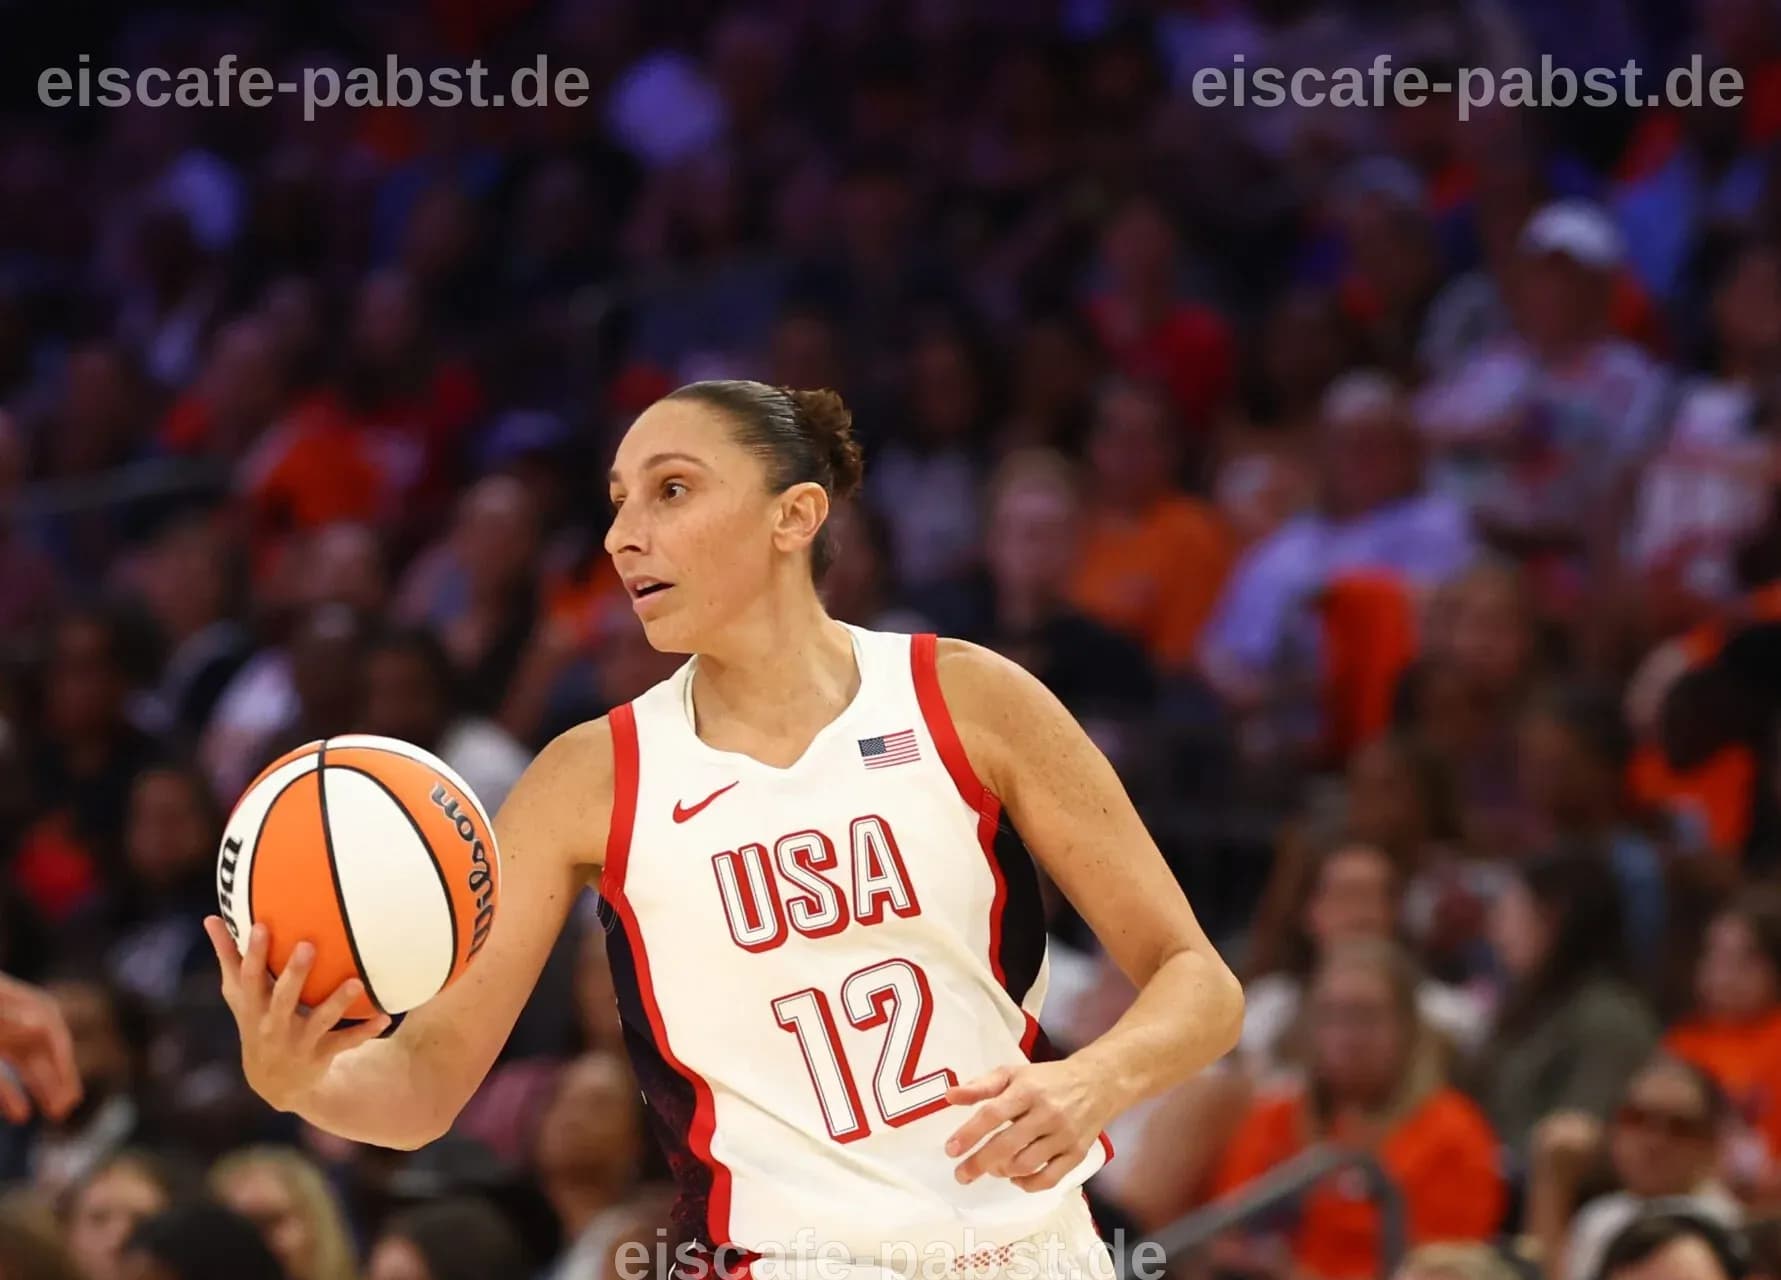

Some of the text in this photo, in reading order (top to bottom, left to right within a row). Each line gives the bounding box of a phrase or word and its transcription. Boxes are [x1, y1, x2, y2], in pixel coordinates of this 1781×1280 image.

[429, 782, 494, 962] Wilson
[711, 814, 922, 953] USA
[771, 958, 958, 1144] 12
